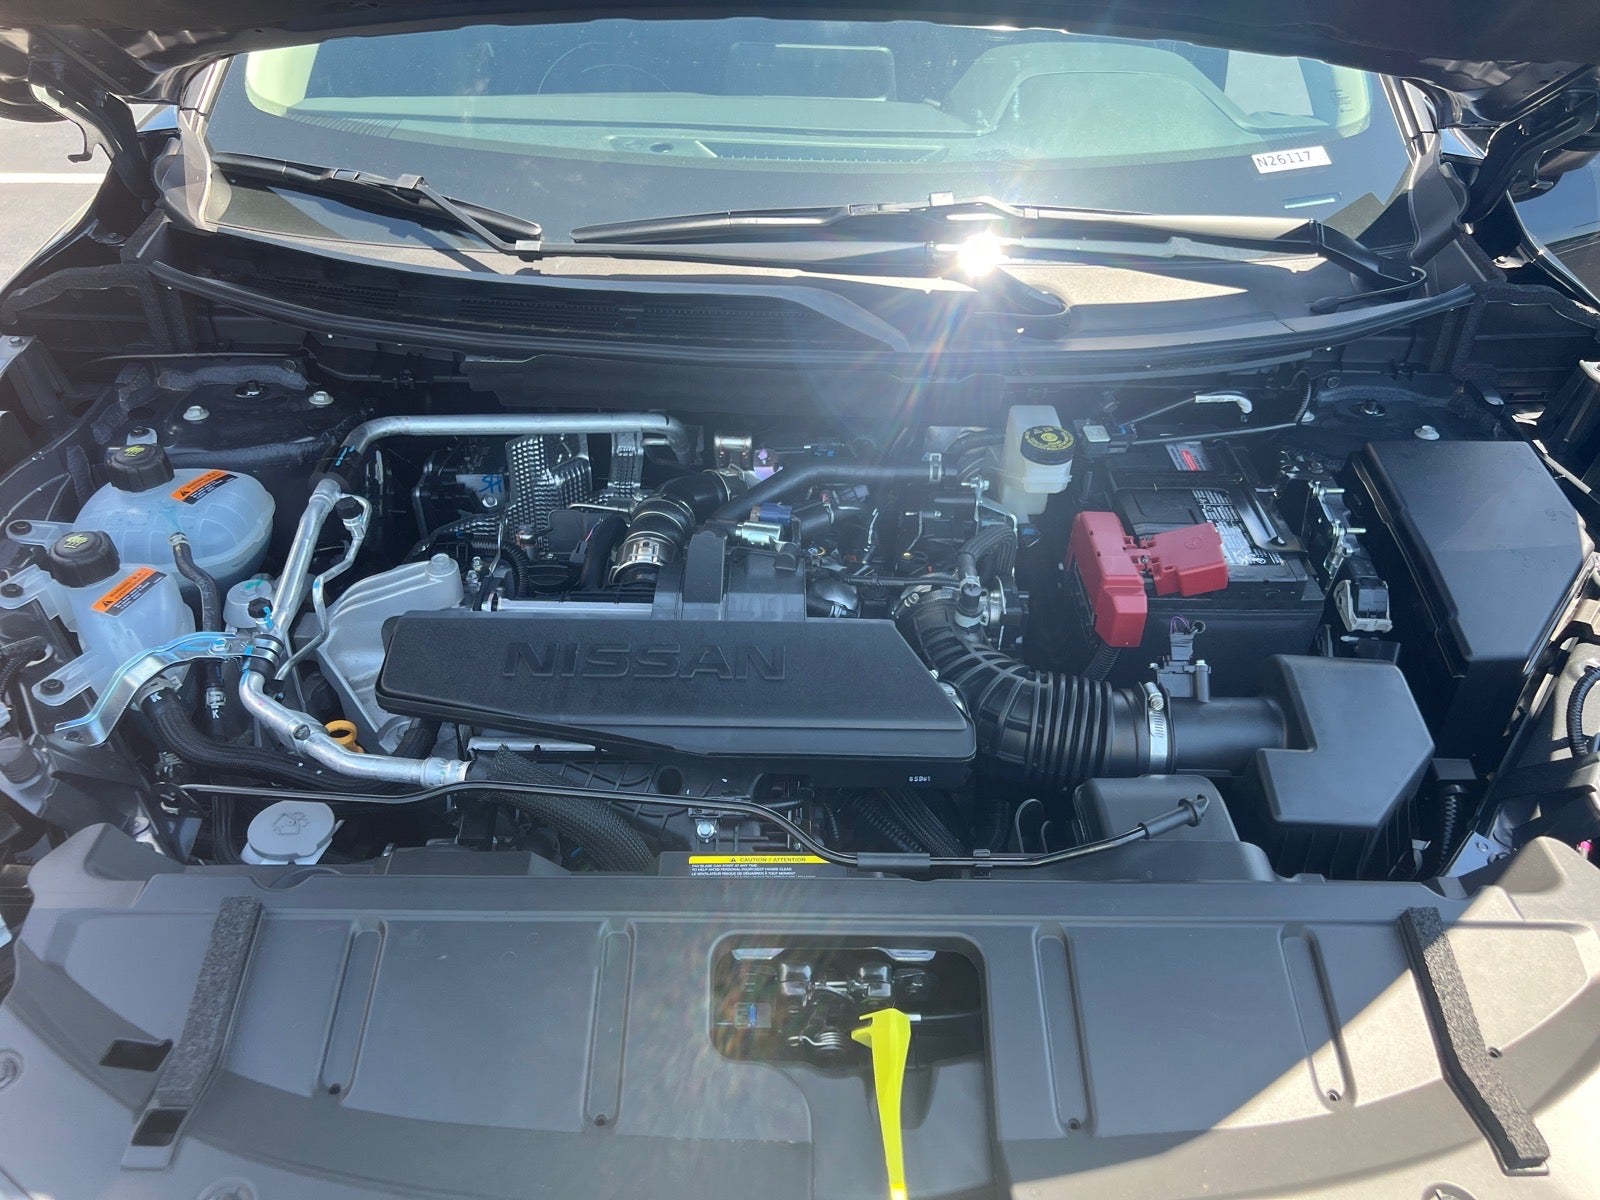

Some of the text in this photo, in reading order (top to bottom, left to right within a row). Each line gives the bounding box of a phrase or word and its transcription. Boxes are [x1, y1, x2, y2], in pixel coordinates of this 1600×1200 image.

[1256, 150, 1311, 168] N26117
[502, 642, 786, 680] NISSAN
[212, 709, 219, 719] K
